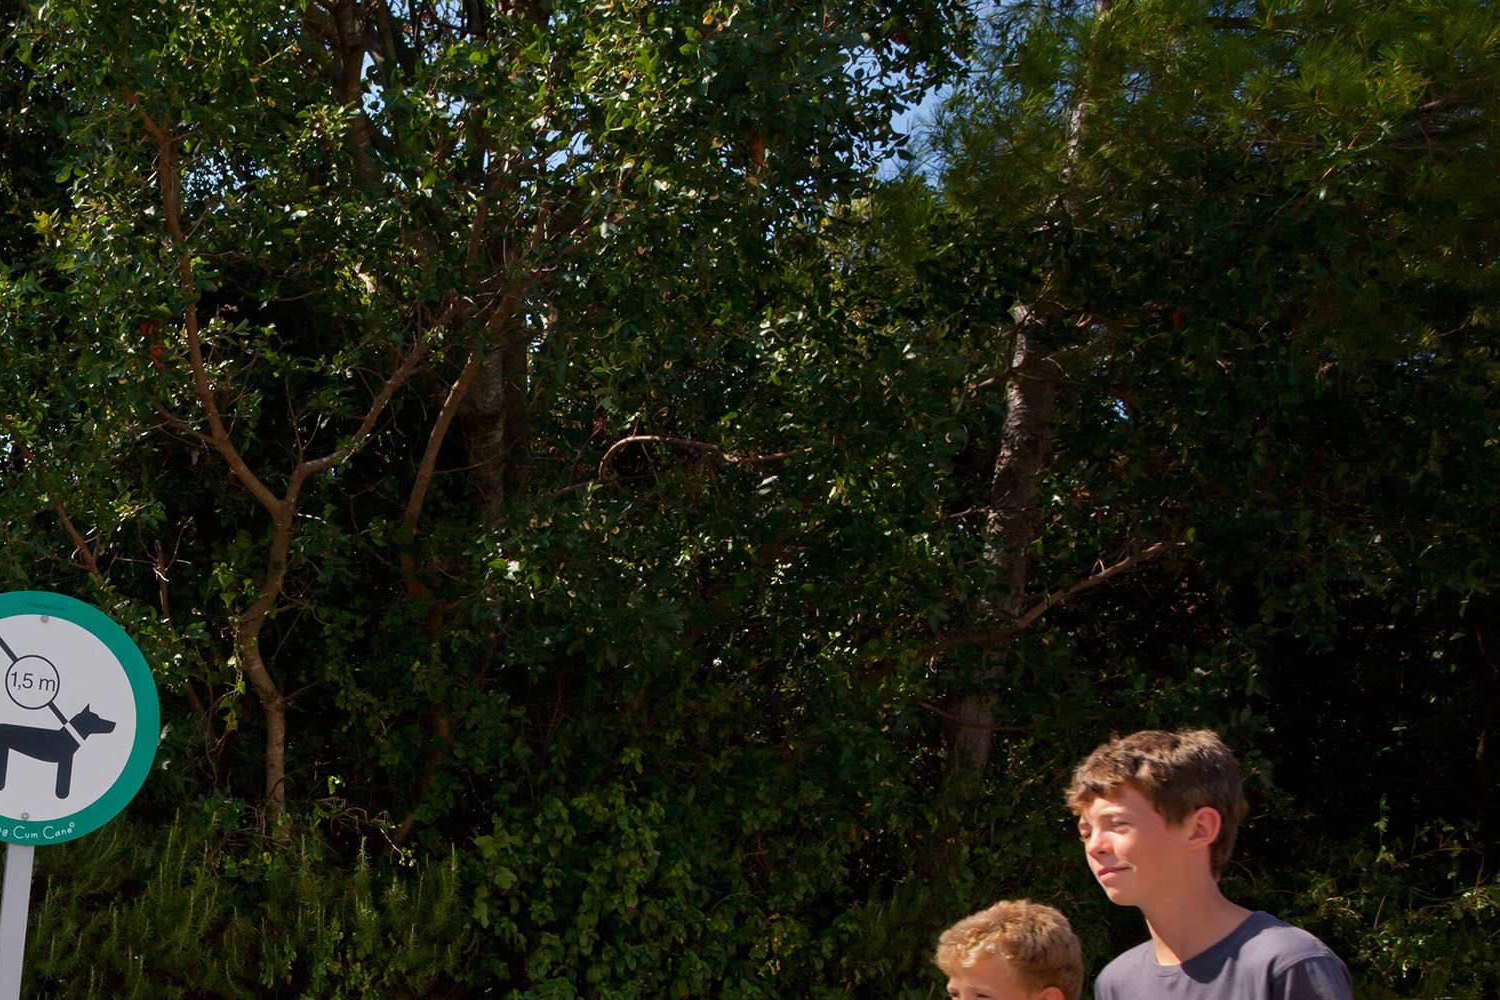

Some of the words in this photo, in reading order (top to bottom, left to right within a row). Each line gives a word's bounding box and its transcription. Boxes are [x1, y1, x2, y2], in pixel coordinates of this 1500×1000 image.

[10, 671, 34, 690] 1,5
[38, 677, 56, 692] m
[13, 825, 38, 839] Cum
